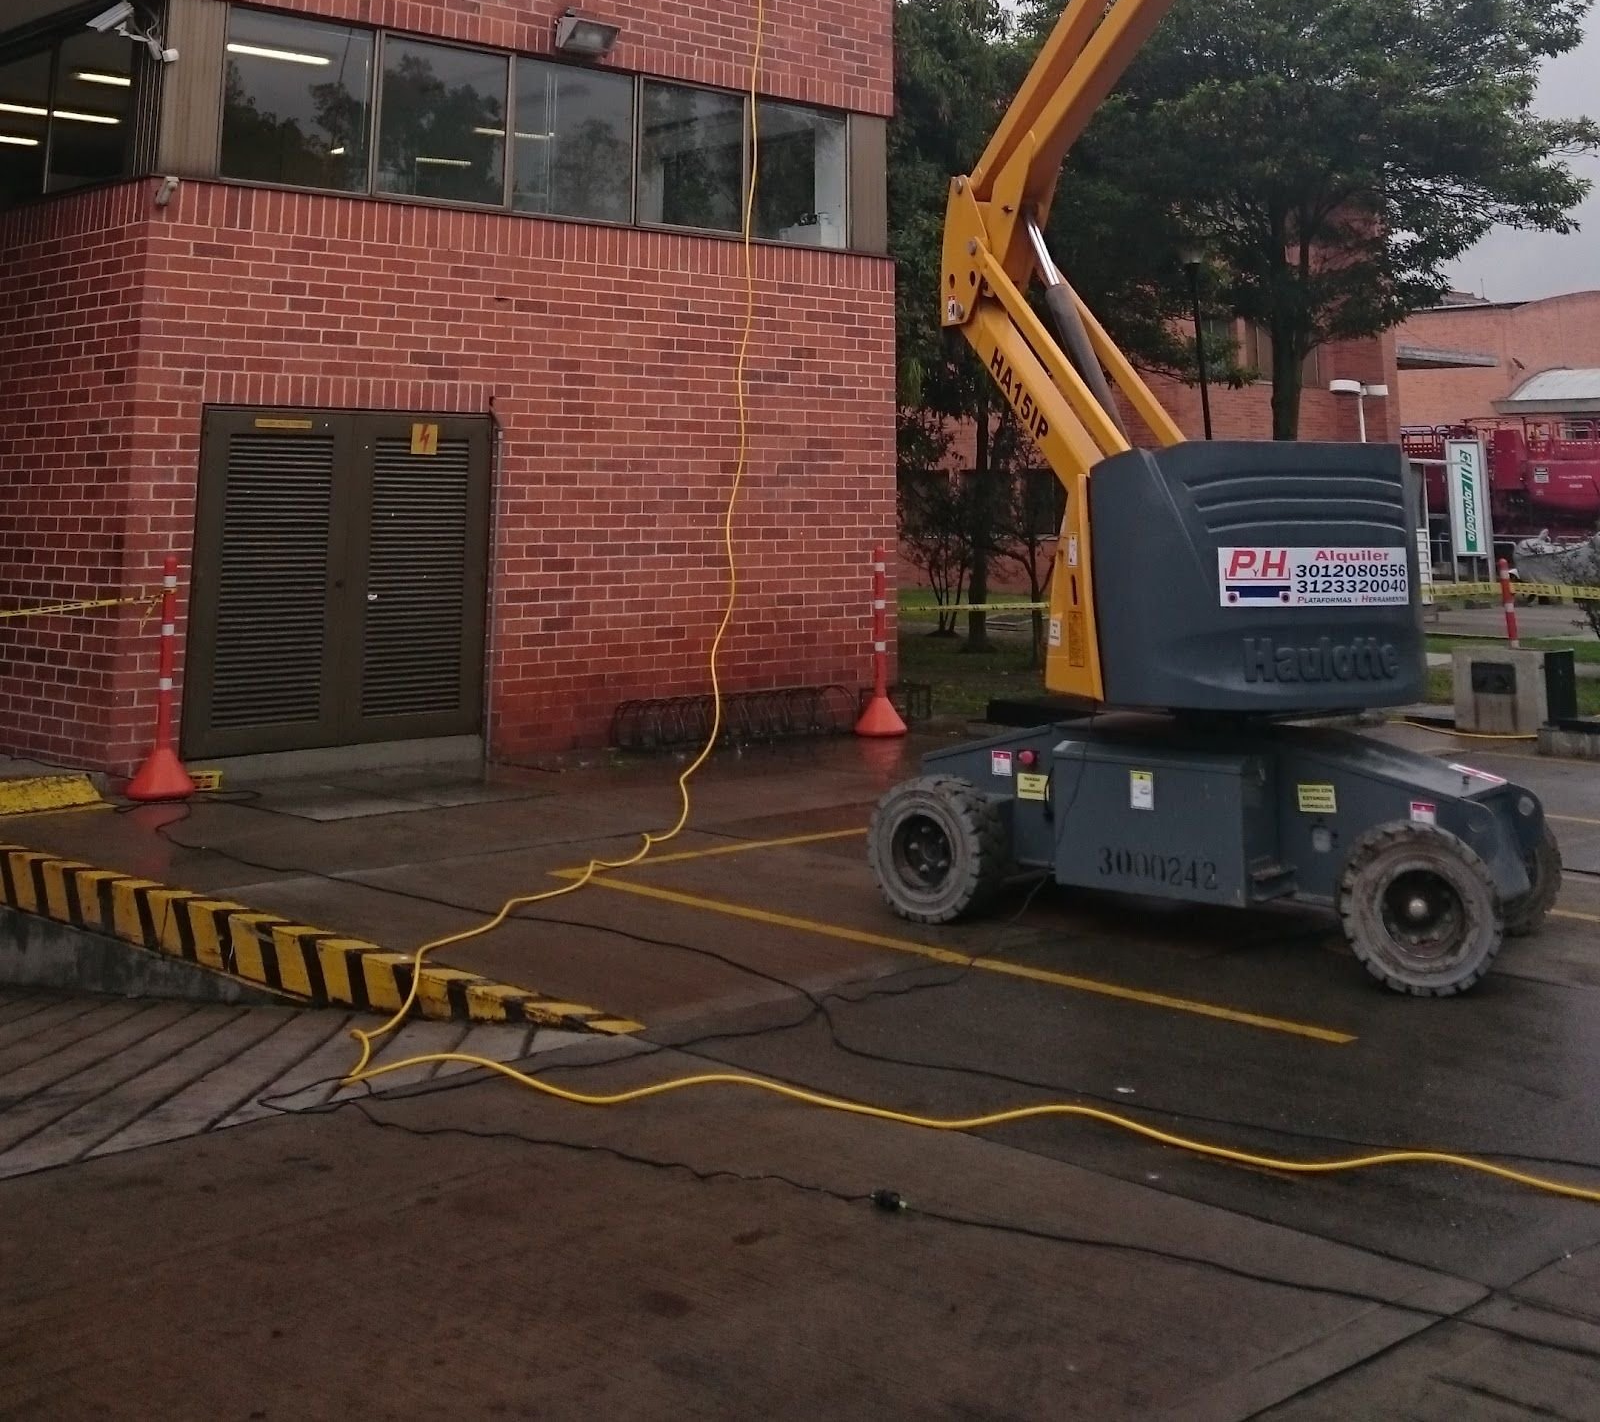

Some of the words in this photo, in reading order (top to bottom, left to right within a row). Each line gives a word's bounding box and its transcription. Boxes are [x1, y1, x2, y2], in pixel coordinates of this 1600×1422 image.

[990, 347, 1049, 440] HA15IP
[1315, 550, 1389, 563] Alquiler
[1296, 564, 1406, 578] 3012080556
[1296, 579, 1407, 593] 3123320040
[1243, 637, 1399, 683] Haulotte
[1098, 847, 1218, 890] 3000242
